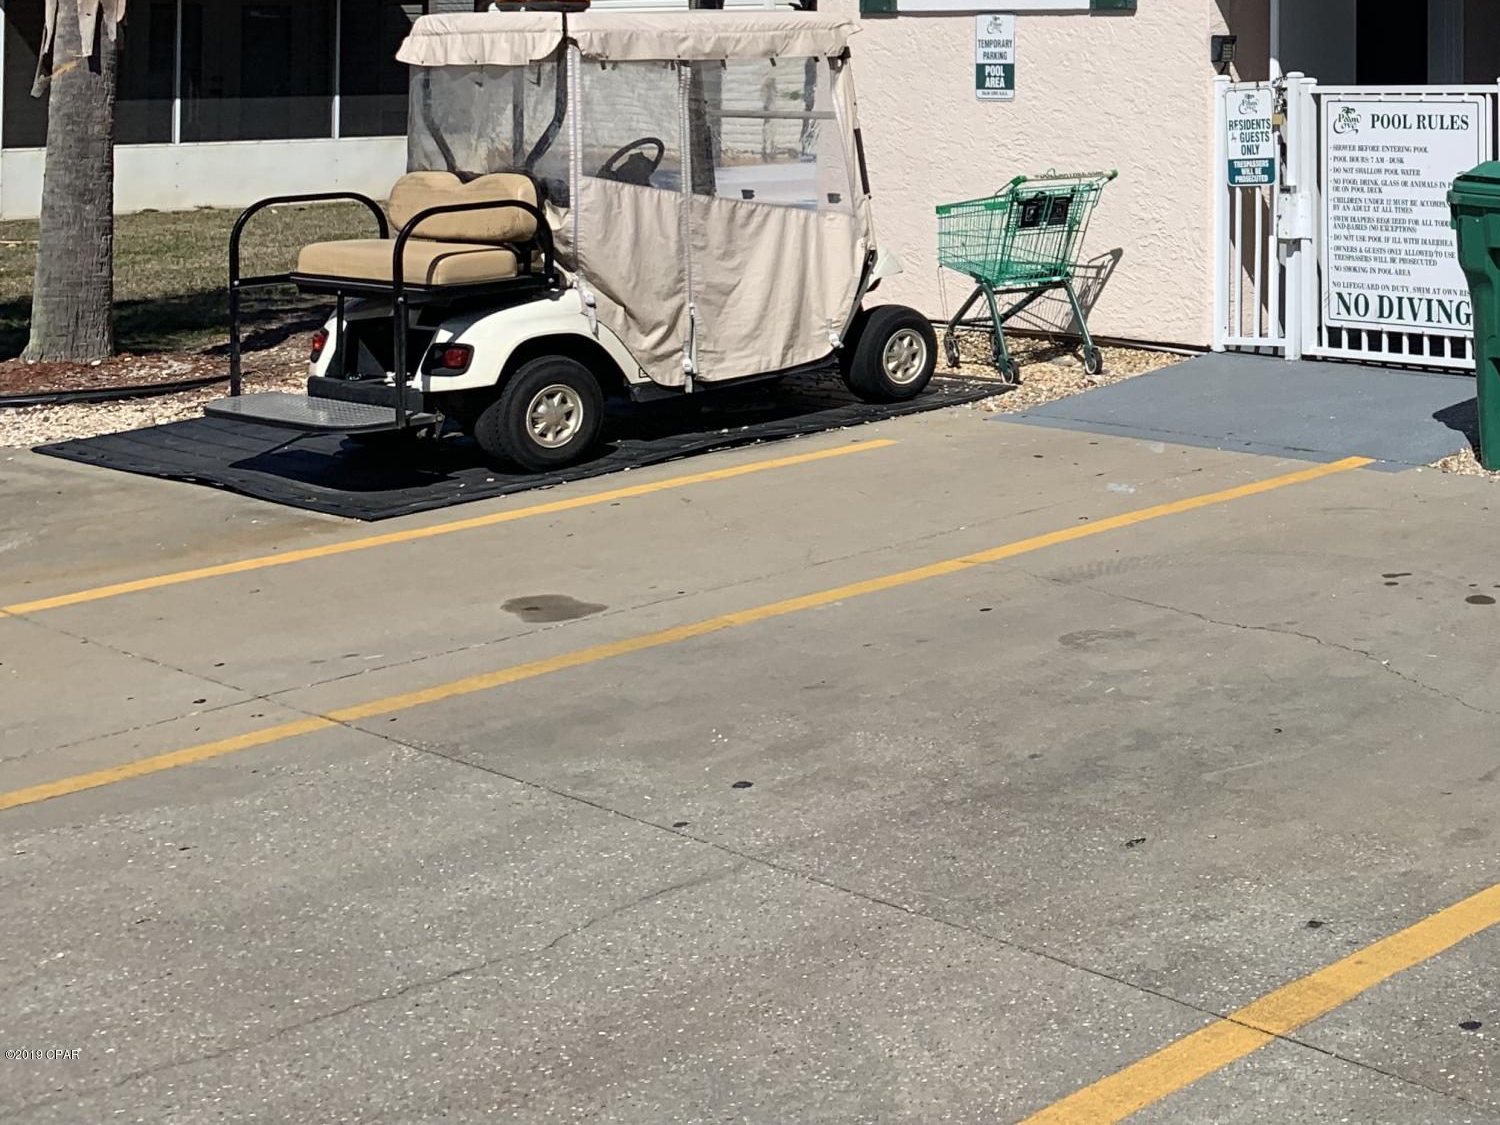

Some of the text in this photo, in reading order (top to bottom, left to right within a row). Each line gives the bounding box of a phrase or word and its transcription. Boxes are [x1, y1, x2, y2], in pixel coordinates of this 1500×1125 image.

[978, 39, 1012, 48] TEMPORARY
[983, 51, 1007, 60] PARKING
[985, 65, 1005, 76] POOL
[985, 77, 1005, 88] AREA
[1228, 119, 1271, 131] RESIDENTS
[1371, 114, 1469, 130] POOL RULES
[1240, 131, 1270, 143] GUESTS
[1241, 144, 1260, 156] ONLY
[1404, 250, 1434, 258] ALLOWED
[1399, 258, 1437, 266] PROSECUTED
[1378, 267, 1393, 275] POOL
[1394, 268, 1411, 276] AREA
[1342, 281, 1379, 291] LIFEGUARD
[1412, 286, 1430, 295] SWIM
[1336, 291, 1473, 326] NO DIVING
